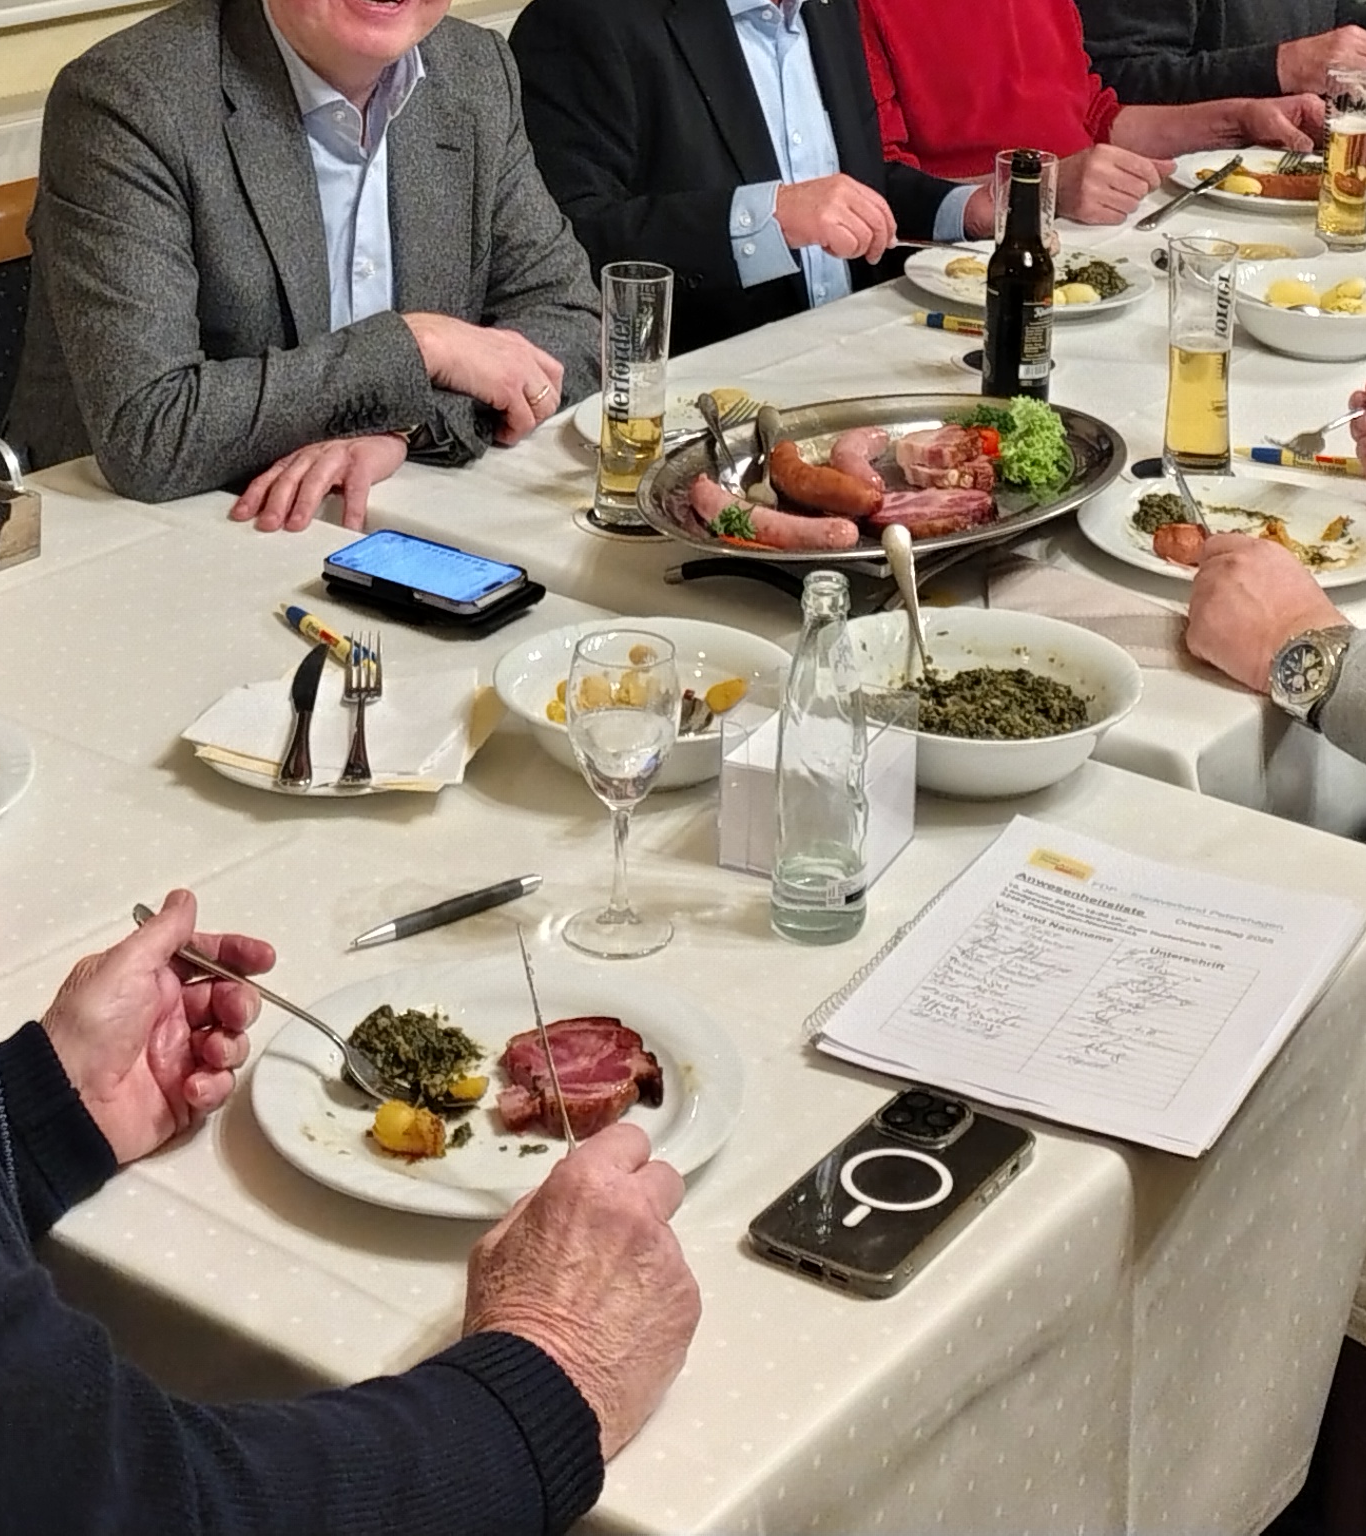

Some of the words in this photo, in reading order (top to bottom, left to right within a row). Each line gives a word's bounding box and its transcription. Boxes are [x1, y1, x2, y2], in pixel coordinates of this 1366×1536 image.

[608, 314, 631, 424] Herforder
[1014, 871, 1146, 917] Anwesenheitsliste
[1022, 912, 1047, 925] und
[1048, 920, 1115, 944] Nachname
[1149, 946, 1227, 972] Unterschrift
